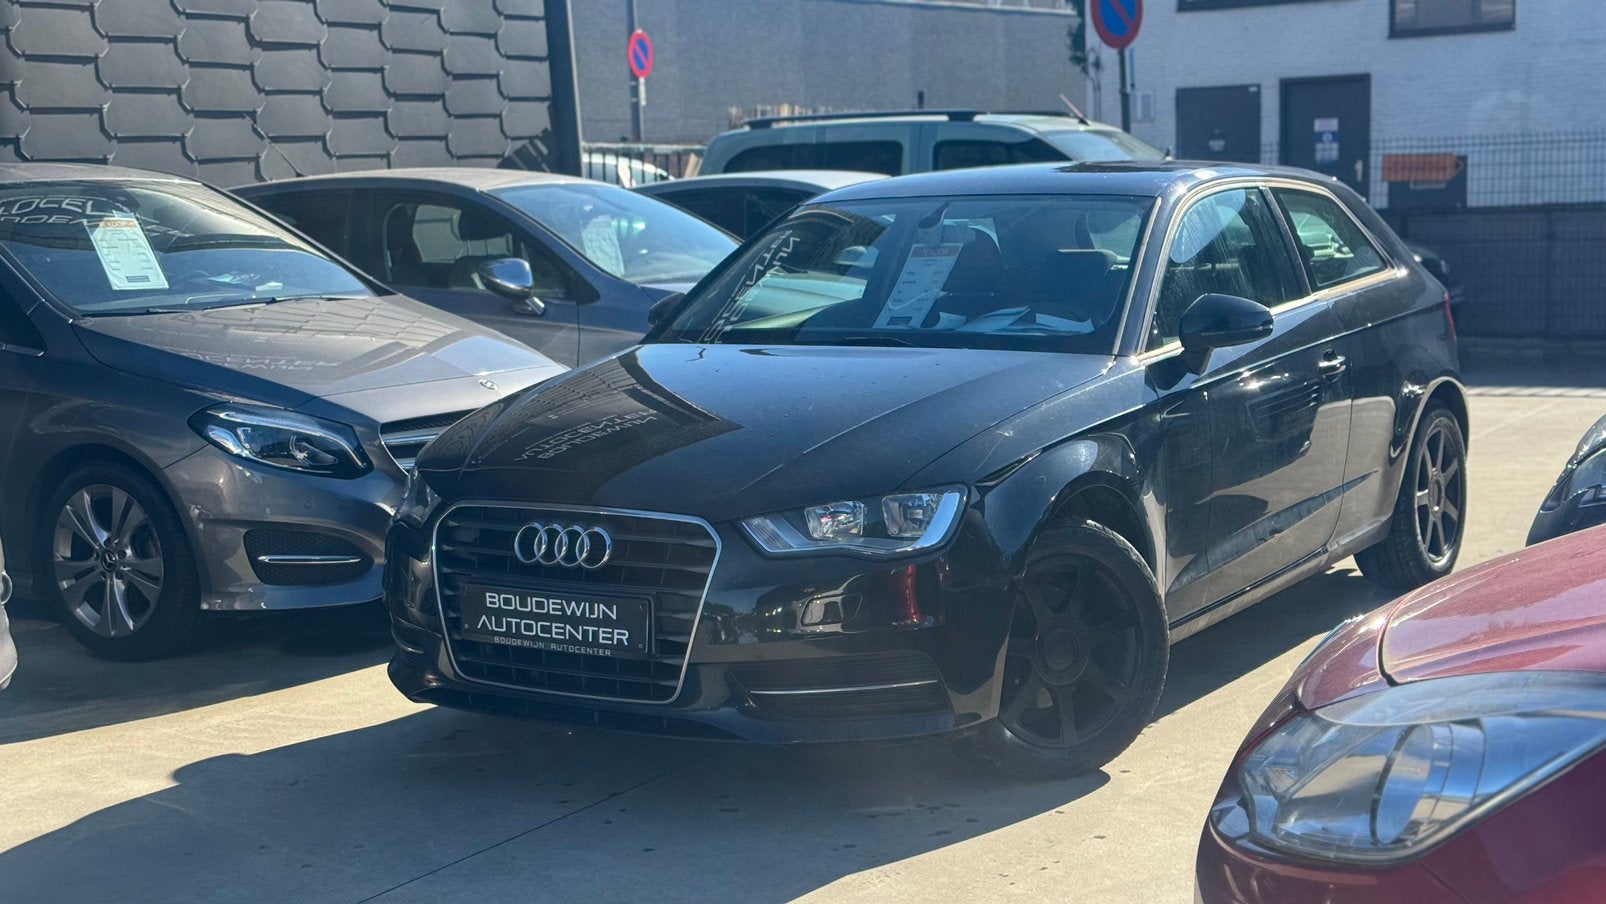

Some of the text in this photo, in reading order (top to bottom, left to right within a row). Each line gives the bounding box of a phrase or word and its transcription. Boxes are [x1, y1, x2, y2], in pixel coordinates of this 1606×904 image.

[485, 592, 617, 620] BOUDEWIJN
[477, 614, 629, 646] AUTOCENTER
[494, 636, 611, 656] BOUDEWIJN AUTOCENTER
